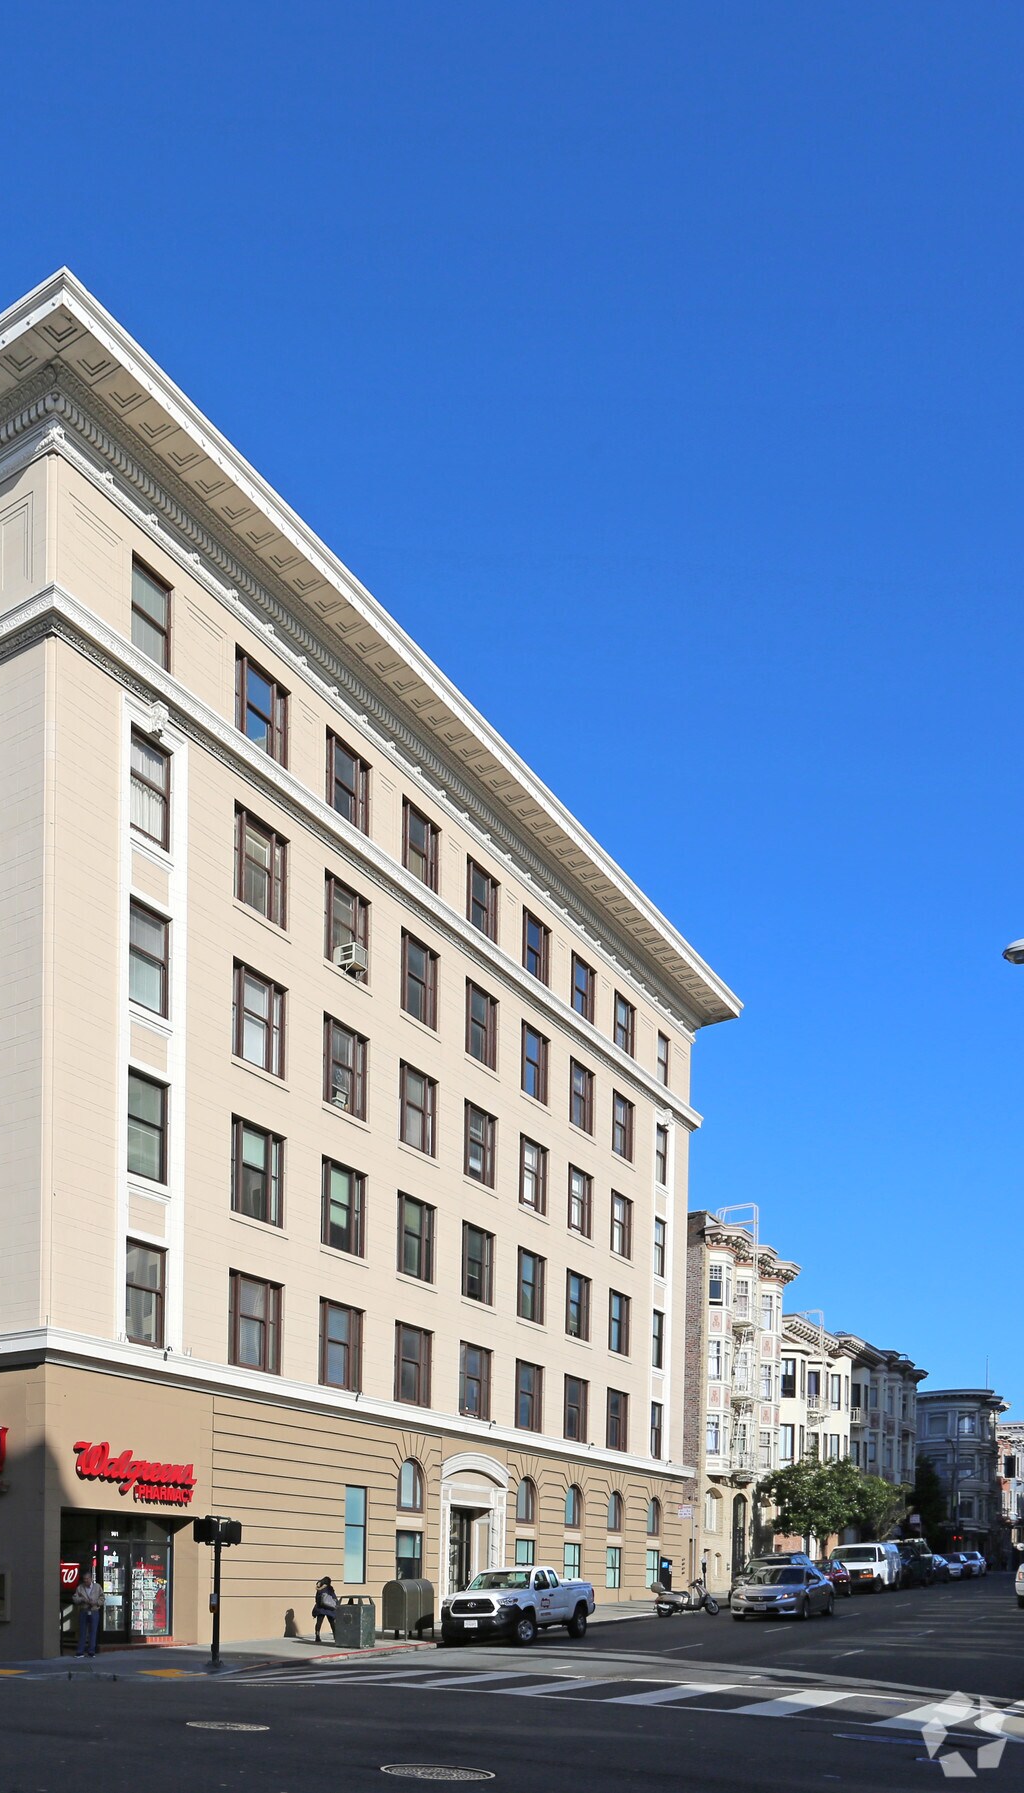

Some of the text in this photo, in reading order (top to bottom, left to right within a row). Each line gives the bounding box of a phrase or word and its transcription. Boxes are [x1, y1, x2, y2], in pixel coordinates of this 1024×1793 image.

[73, 1441, 197, 1496] Walgreens
[134, 1485, 194, 1503] PHARMACY
[61, 1568, 78, 1583] W
